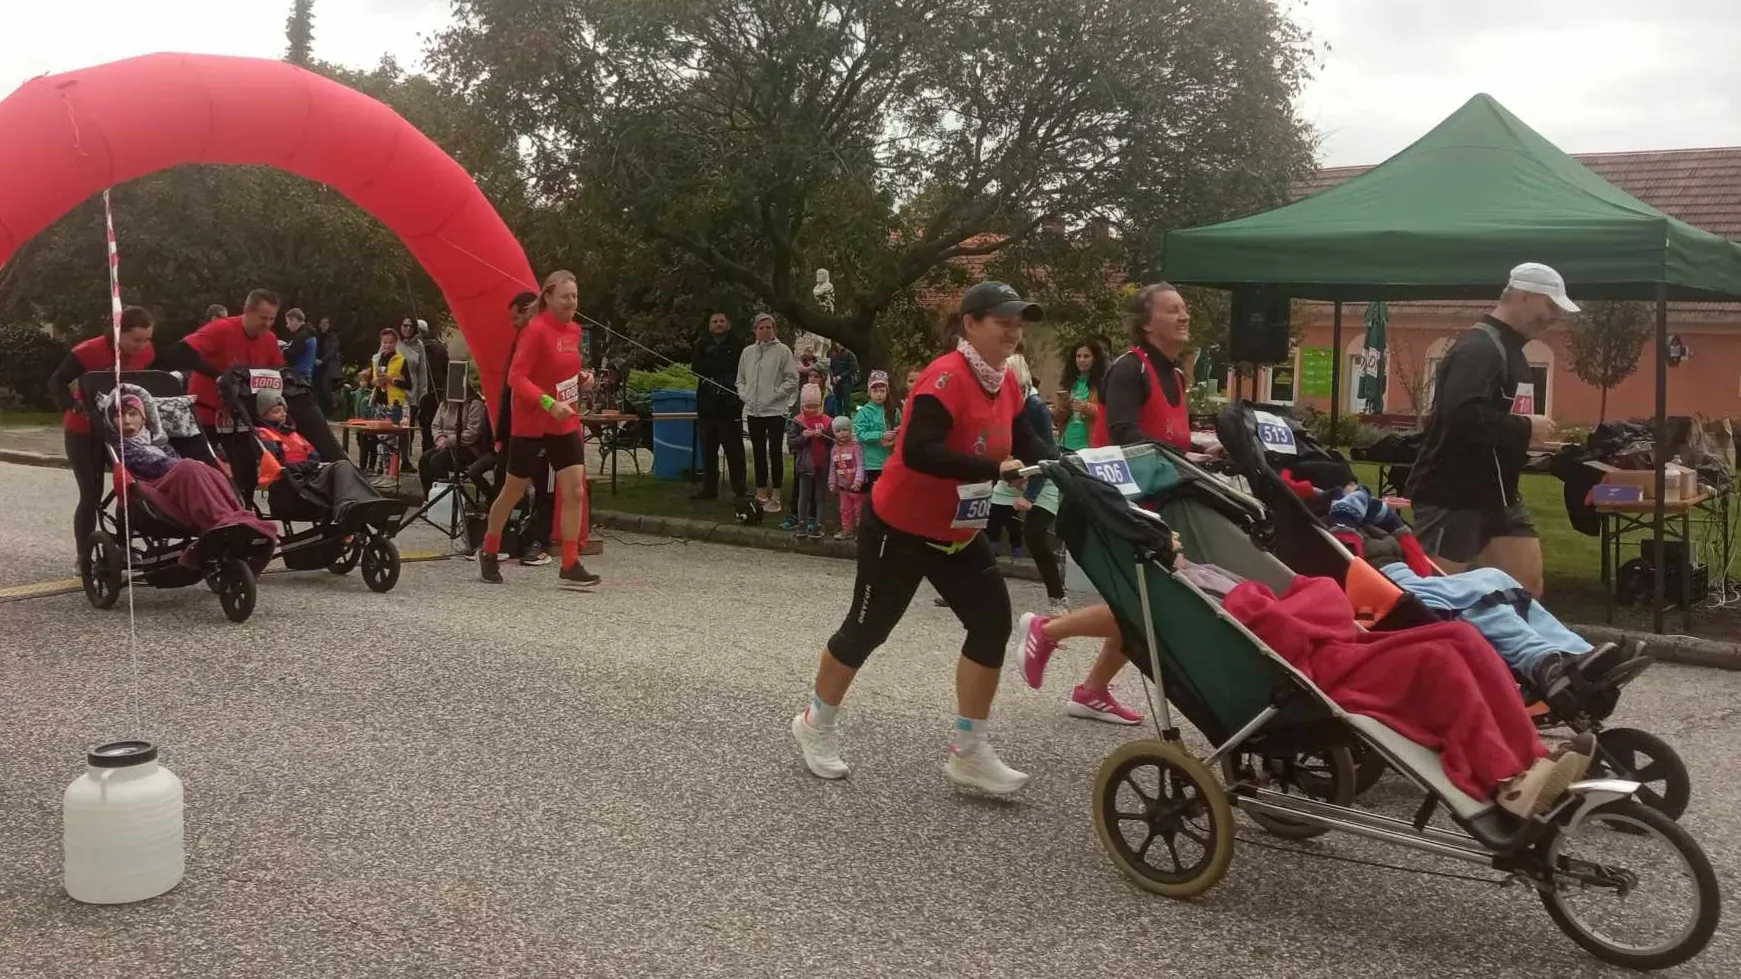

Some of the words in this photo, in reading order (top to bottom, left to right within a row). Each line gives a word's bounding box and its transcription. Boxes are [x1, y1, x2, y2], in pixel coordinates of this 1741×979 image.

[254, 377, 280, 389] 1006
[1263, 425, 1288, 444] 513
[1095, 463, 1124, 483] 506
